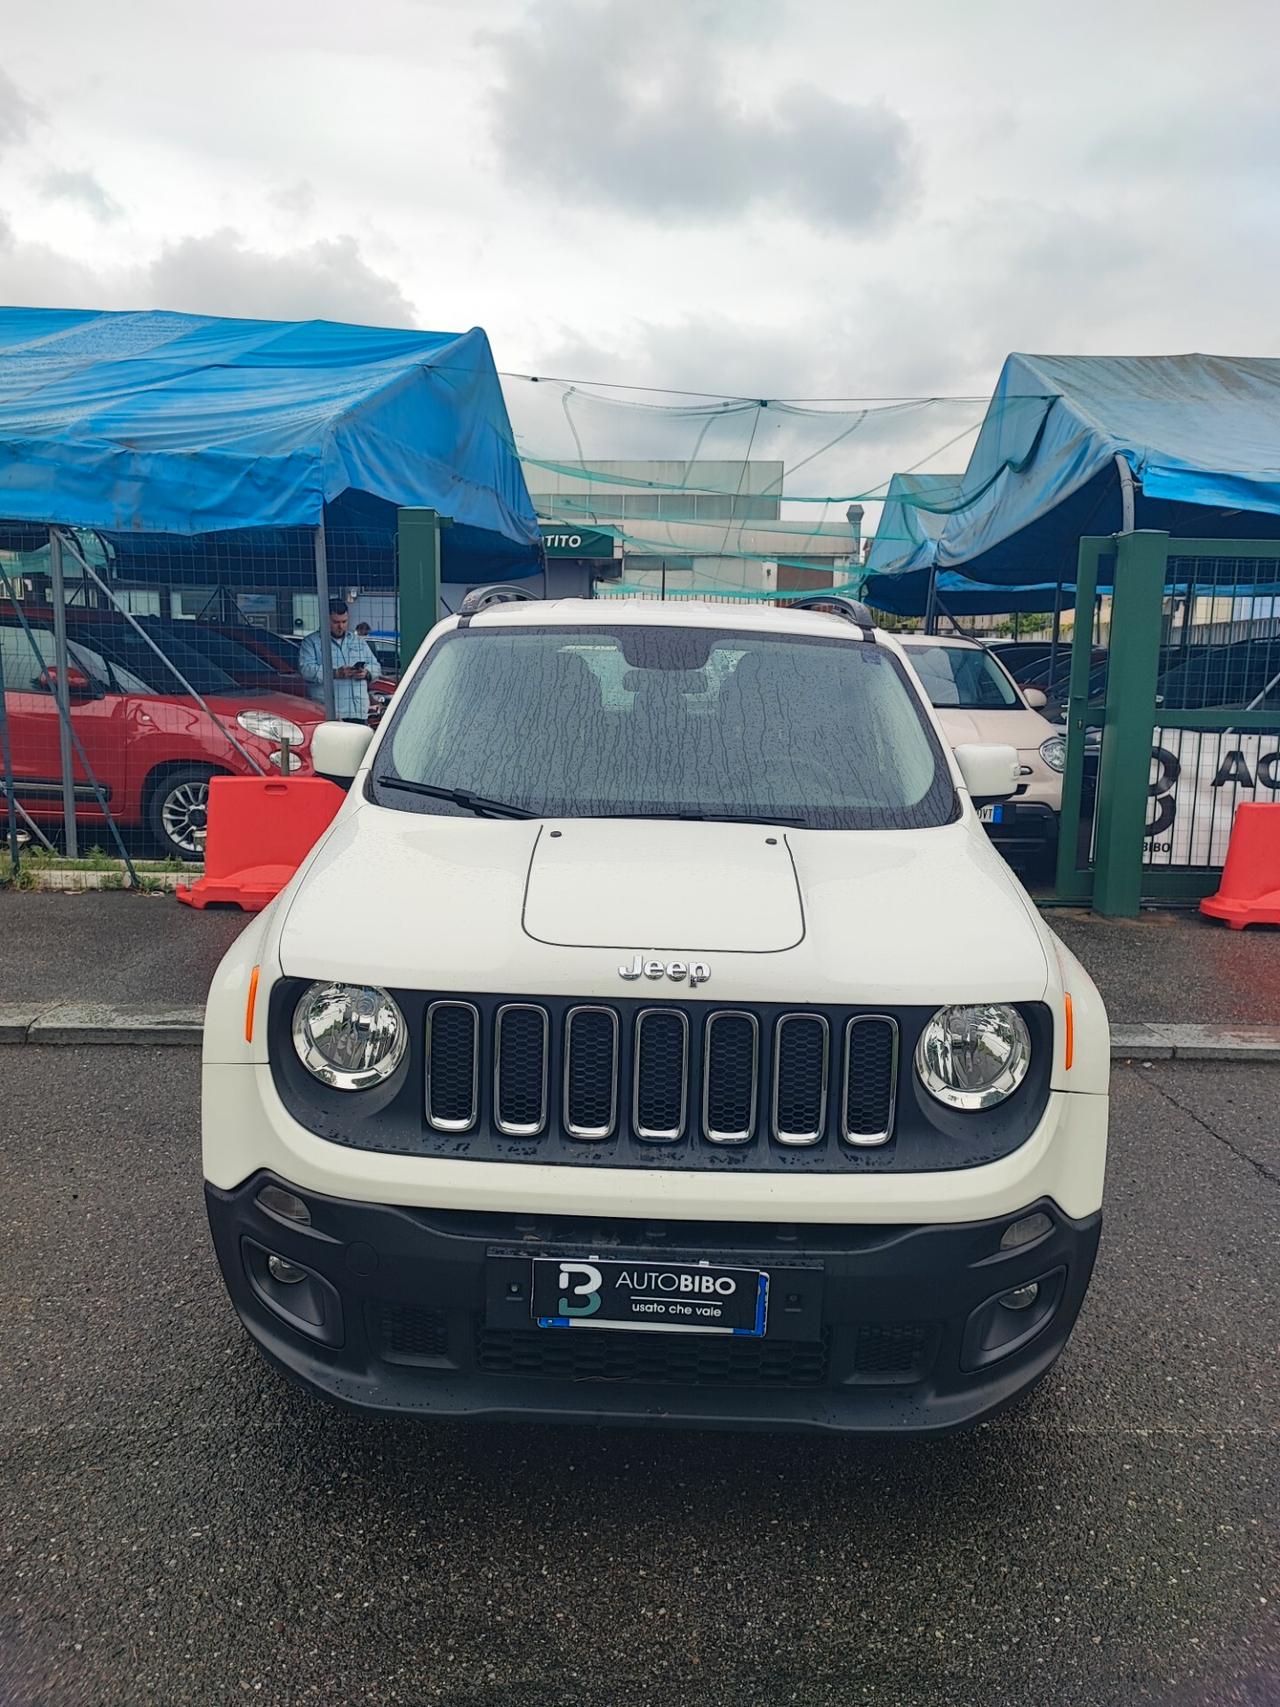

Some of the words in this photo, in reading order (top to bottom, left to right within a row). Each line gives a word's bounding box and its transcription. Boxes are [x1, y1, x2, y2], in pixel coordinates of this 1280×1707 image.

[541, 534, 582, 549] TITO
[618, 954, 711, 988] Jeep
[614, 1271, 737, 1295] AUTOBIBO
[632, 1301, 666, 1314] usato
[668, 1303, 693, 1316] che
[695, 1304, 723, 1318] vale
